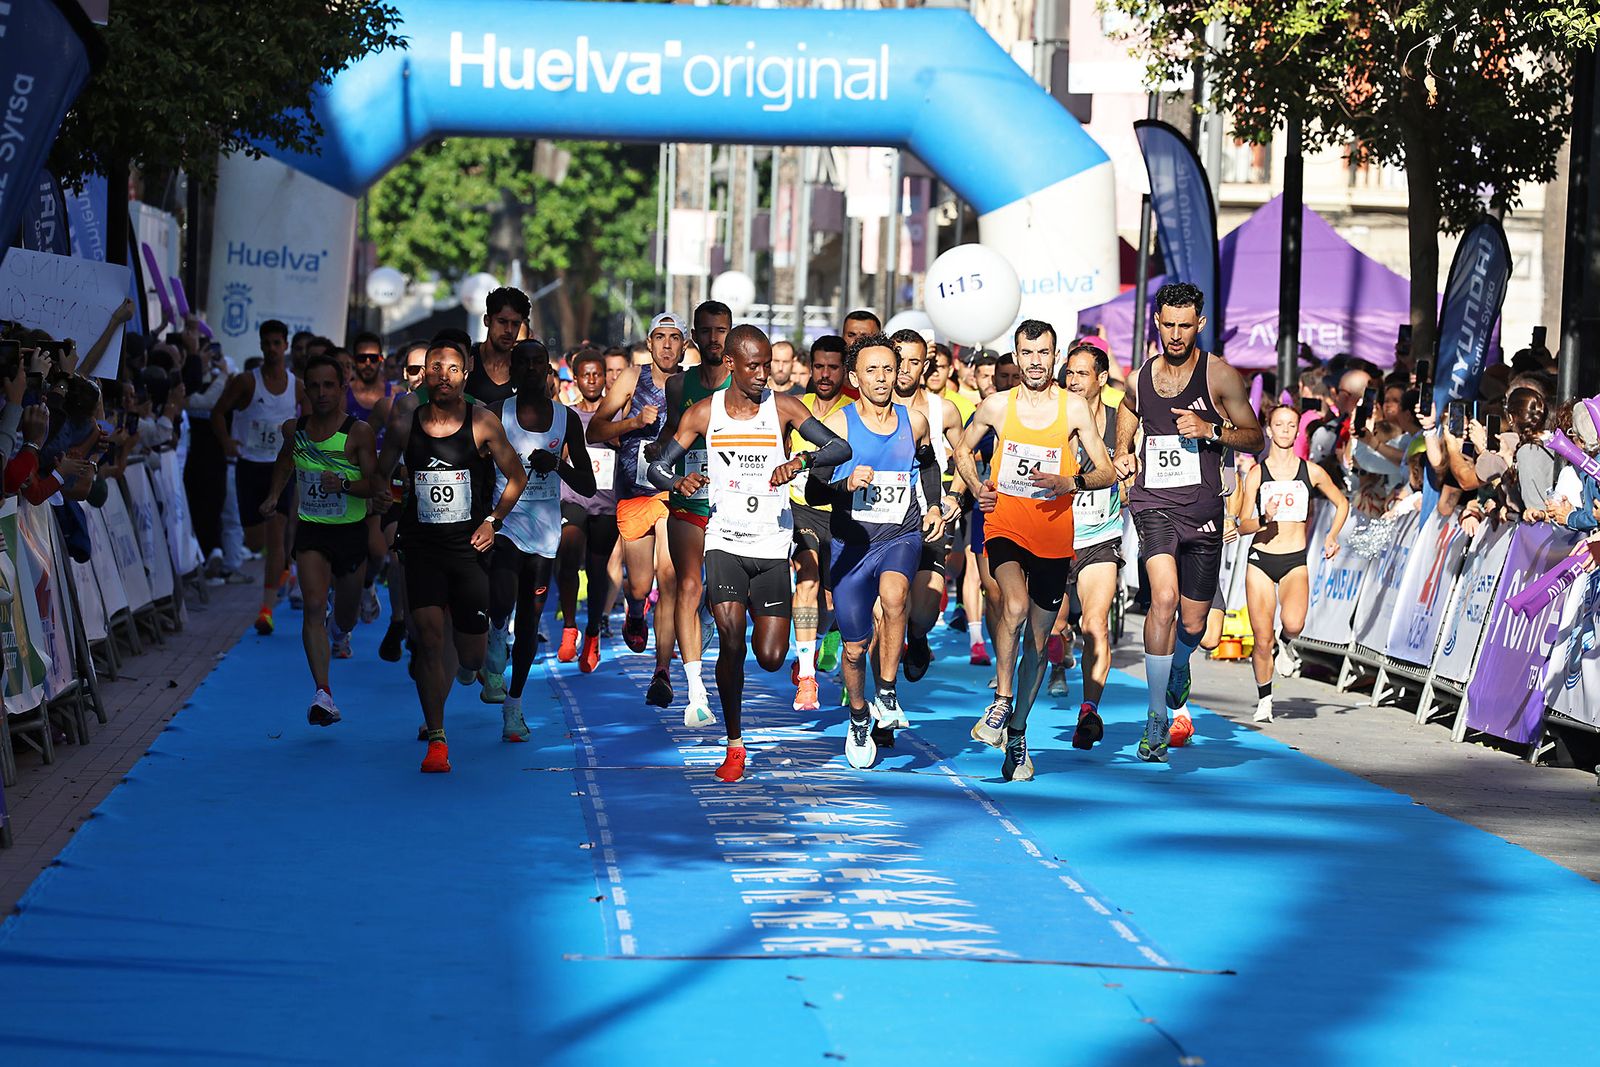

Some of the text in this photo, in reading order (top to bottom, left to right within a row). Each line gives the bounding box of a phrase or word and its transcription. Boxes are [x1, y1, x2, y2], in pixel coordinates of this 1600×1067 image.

[449, 31, 889, 112] Huelva original
[227, 241, 320, 272] Huelva
[937, 273, 984, 299] 1:15
[1020, 271, 1094, 296] uelva
[1480, 282, 1496, 326] Syrsa
[1448, 237, 1493, 400] HYUNDAI
[1247, 323, 1350, 347] AVTEL
[259, 431, 276, 444] 15
[737, 454, 768, 463] VICKY
[1016, 458, 1042, 477] 54
[1158, 449, 1181, 468] 56
[429, 485, 454, 503] 69
[859, 485, 906, 504] 1337
[1274, 493, 1294, 507] 76
[746, 496, 759, 514] 9
